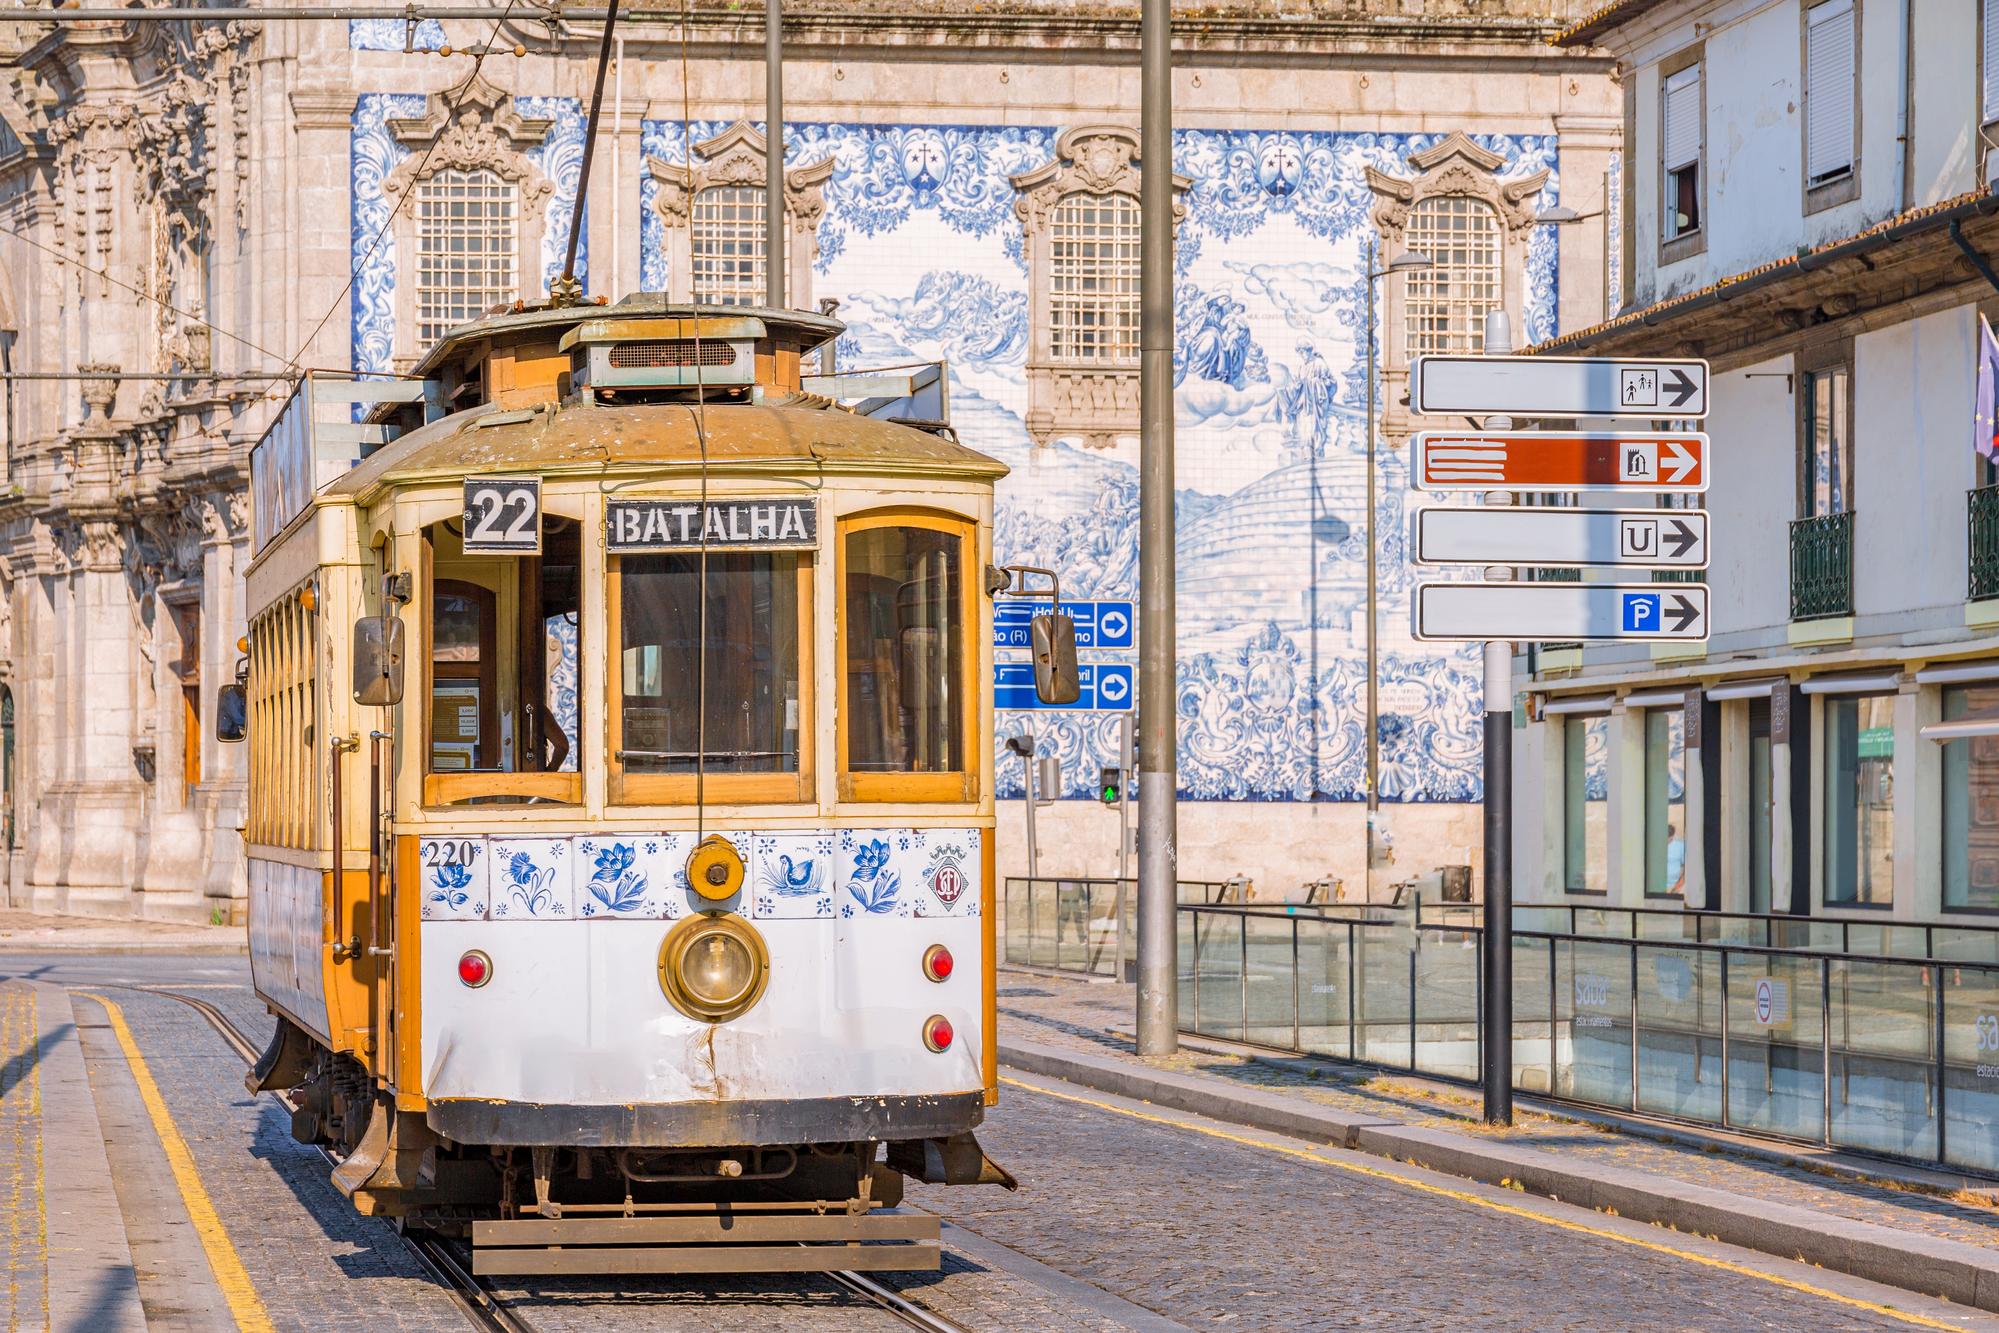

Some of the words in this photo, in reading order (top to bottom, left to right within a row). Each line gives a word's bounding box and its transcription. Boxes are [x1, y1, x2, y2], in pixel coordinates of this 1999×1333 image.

[473, 489, 537, 541] 22
[616, 505, 808, 543] BATALHA
[1010, 630, 1027, 645] (R)
[1074, 633, 1091, 643] no
[426, 841, 475, 868] 220
